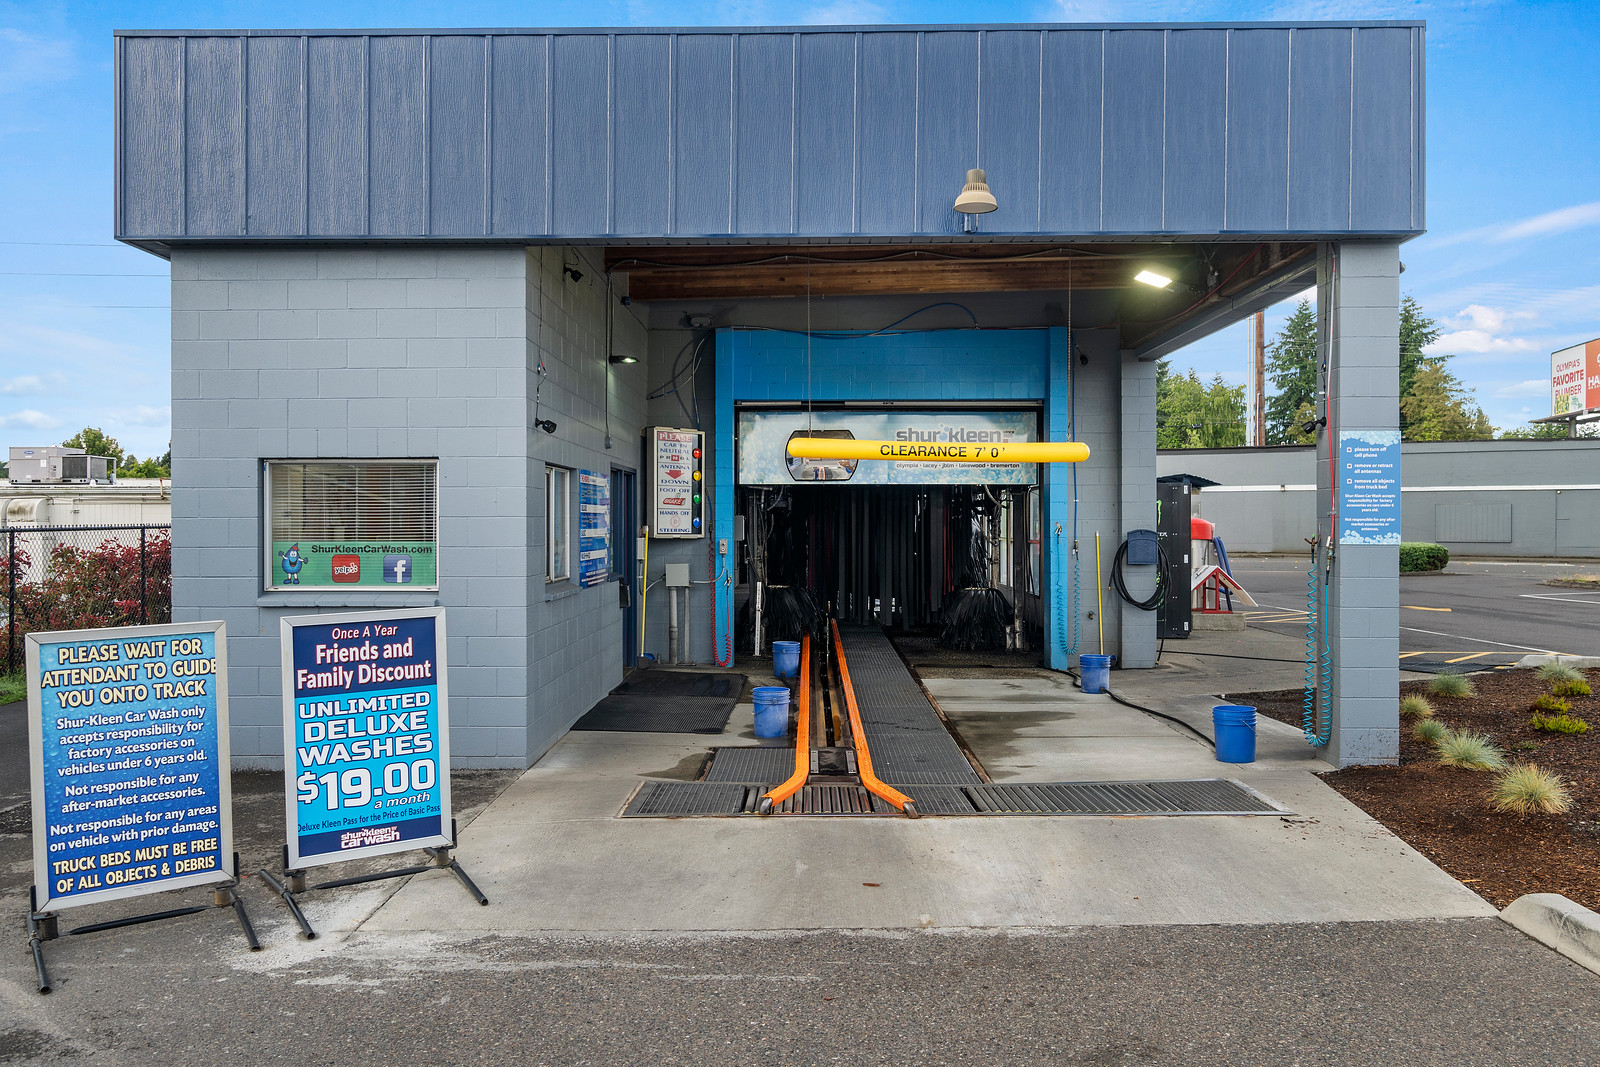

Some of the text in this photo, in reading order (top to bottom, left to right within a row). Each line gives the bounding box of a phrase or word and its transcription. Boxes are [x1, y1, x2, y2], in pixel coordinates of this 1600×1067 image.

[1553, 369, 1584, 387] FAVORITE
[1556, 359, 1580, 372] OLYMPIA'S
[1555, 384, 1581, 397] PLUMBER
[660, 432, 690, 441] PLEASE
[896, 427, 1001, 442] shur kleen
[880, 444, 967, 458] CLEARANCE
[312, 544, 432, 554] ShurKleenCarWash.com
[334, 566, 350, 575] yelp
[332, 624, 398, 640] Once A Year
[58, 638, 202, 664] PLEASE WAIT FOR
[316, 637, 413, 665] Friends and
[41, 658, 216, 688] ATTENDANT TO GUIDE
[297, 659, 432, 690] Family Discount
[57, 680, 206, 708] YOU ONTO TRACK
[299, 691, 430, 719] UNLIMITED
[57, 705, 205, 730] Shur-Kleen Car Wash only
[304, 710, 428, 743] DELUXE
[60, 721, 203, 745] accepts responsibility for
[67, 738, 195, 759] factory accessories on
[297, 732, 434, 768] WASHES
[58, 750, 207, 776] vehicles under 6 years old.
[65, 772, 199, 797] Not responsible for any
[297, 758, 436, 811] $19.00
[61, 787, 206, 814] after-market accessories.
[374, 792, 431, 809] a month
[50, 805, 217, 836] Not responsible for any areas
[298, 804, 440, 833] Deluxe Kleen Pass for the Price of Basic Pass
[50, 820, 219, 852] on vehicle with prior damage.
[341, 832, 362, 840] shur
[364, 827, 391, 836] kleen
[52, 838, 218, 875] TRUCK BEDS MUST BE FREE
[56, 856, 215, 893] OF ALL OBJECTS & DEBRIS
